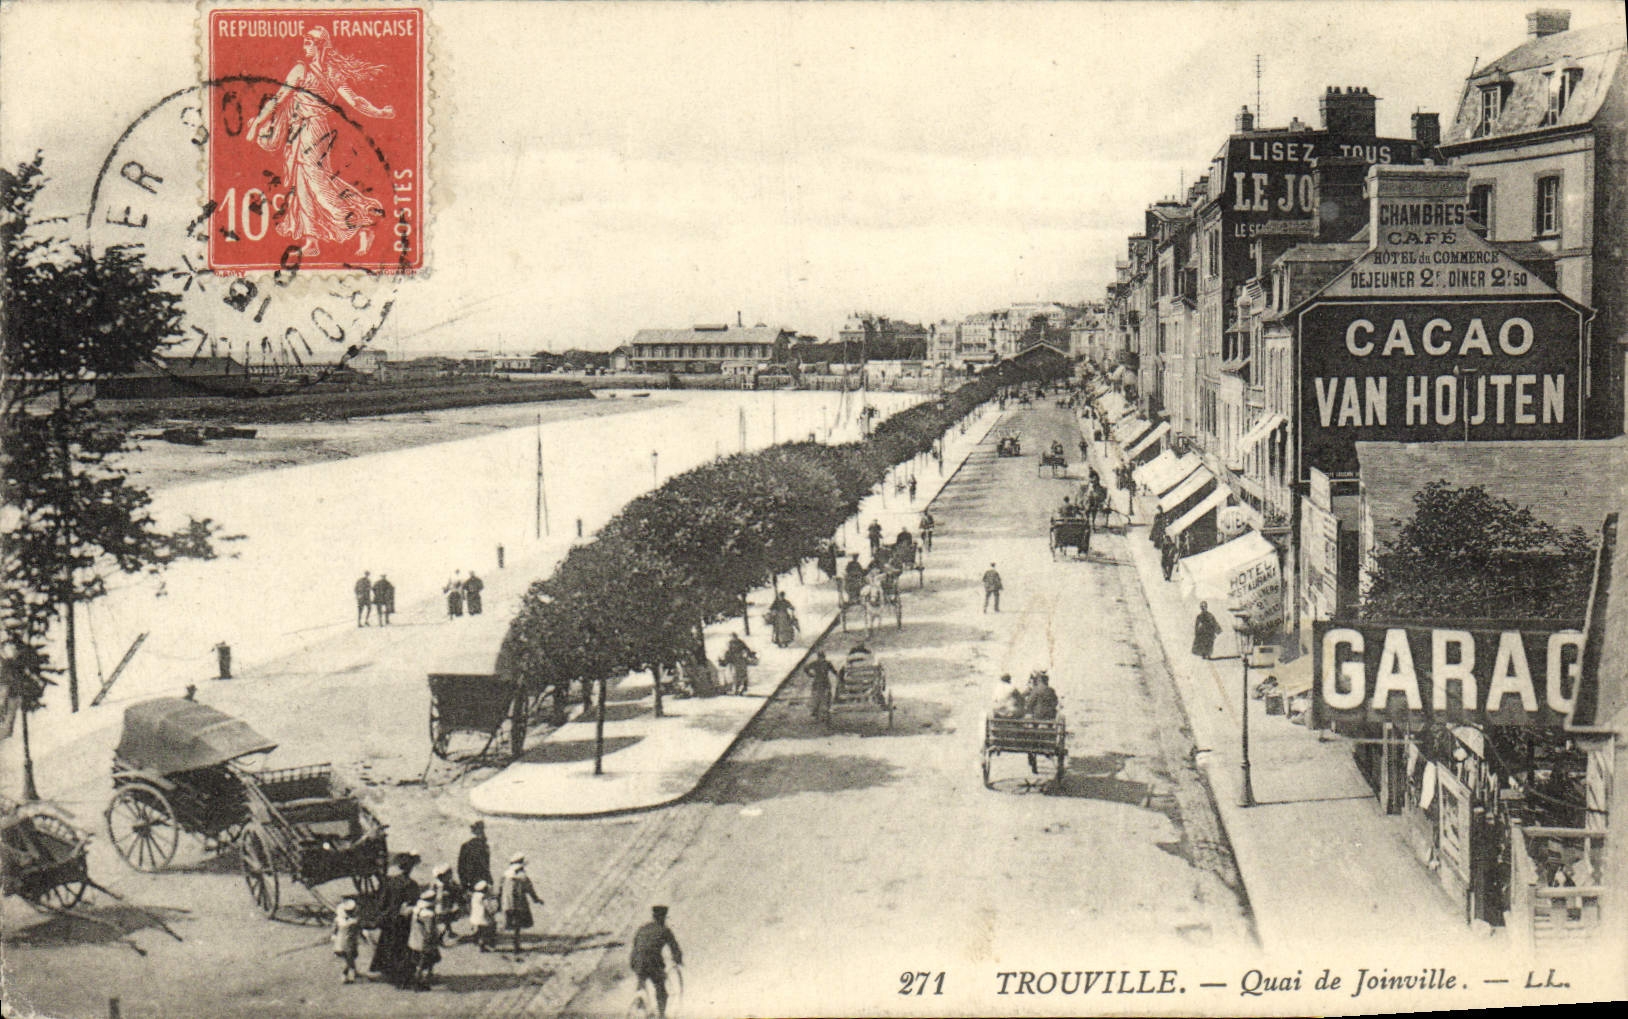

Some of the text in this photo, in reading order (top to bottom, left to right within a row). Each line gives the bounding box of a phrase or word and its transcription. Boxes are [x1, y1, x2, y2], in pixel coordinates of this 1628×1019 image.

[332, 19, 414, 38] FRANÇAISE
[1249, 141, 1392, 164] LISEZ TOUS
[1233, 172, 1268, 212] LE
[393, 168, 413, 252] POSTES
[1379, 203, 1465, 226] CHAMBRES
[1235, 223, 1246, 238] LE
[1387, 228, 1457, 245] CAFÉ
[1419, 252, 1431, 264] du
[1433, 250, 1499, 265] COMMERCE
[1345, 317, 1535, 356] CACAO
[1315, 373, 1565, 427] VAN HOUTEN
